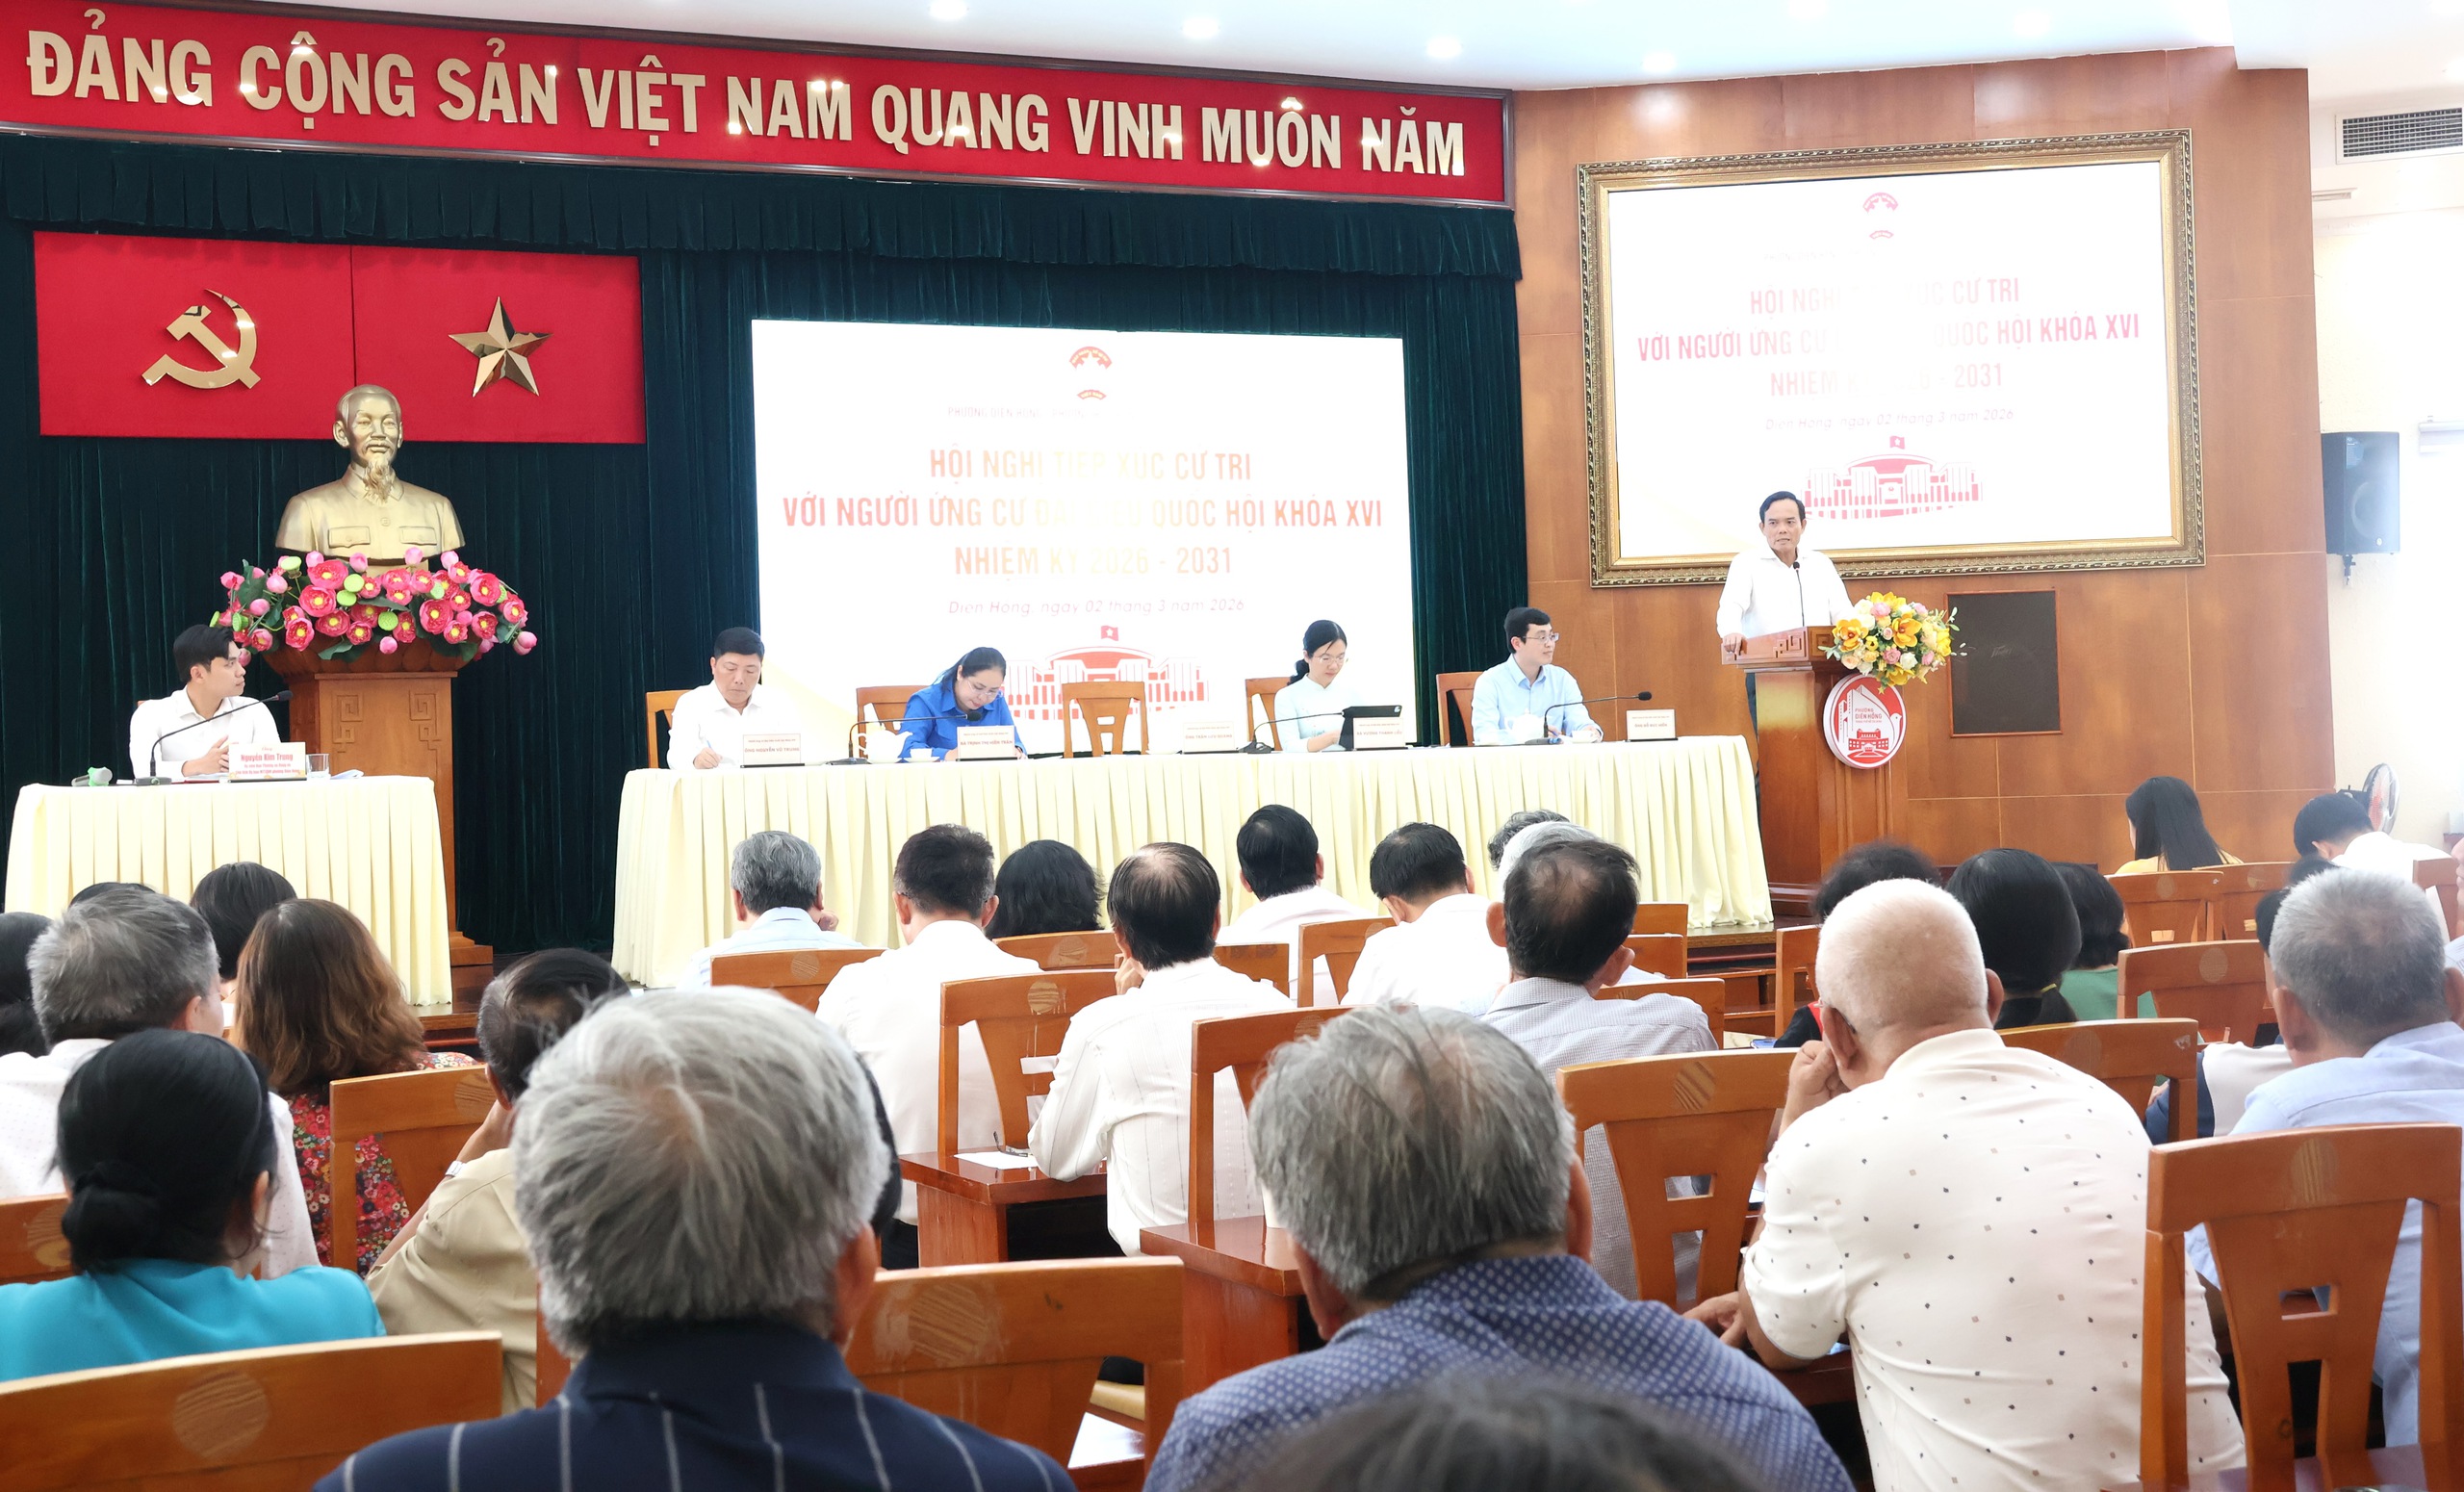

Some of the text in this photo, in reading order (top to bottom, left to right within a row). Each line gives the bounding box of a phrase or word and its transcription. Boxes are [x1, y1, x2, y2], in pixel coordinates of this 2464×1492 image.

[26, 9, 1465, 176] ĐẢNG CỘNG SẢN VIỆT NAM QUANG VINH MUÔN NĂM
[1988, 277, 2019, 303] TRI
[1637, 330, 1670, 361] VỚI
[2105, 313, 2140, 339] XVI
[1954, 363, 2002, 388] 2031
[1938, 411, 1945, 424] 3
[1983, 408, 2015, 421] 2026
[1215, 452, 1250, 479] TRI
[783, 490, 825, 527] VỚI
[836, 490, 918, 527] NGƯỜI
[929, 491, 982, 527] ỨNG
[1225, 494, 1265, 533] HỘI
[1274, 494, 1338, 527] KHÓA
[1346, 500, 1382, 527] XVI
[1175, 547, 1232, 574] 2031
[1086, 600, 1103, 613] 02
[1158, 599, 1167, 612] 3
[1210, 599, 1245, 612] 2026
